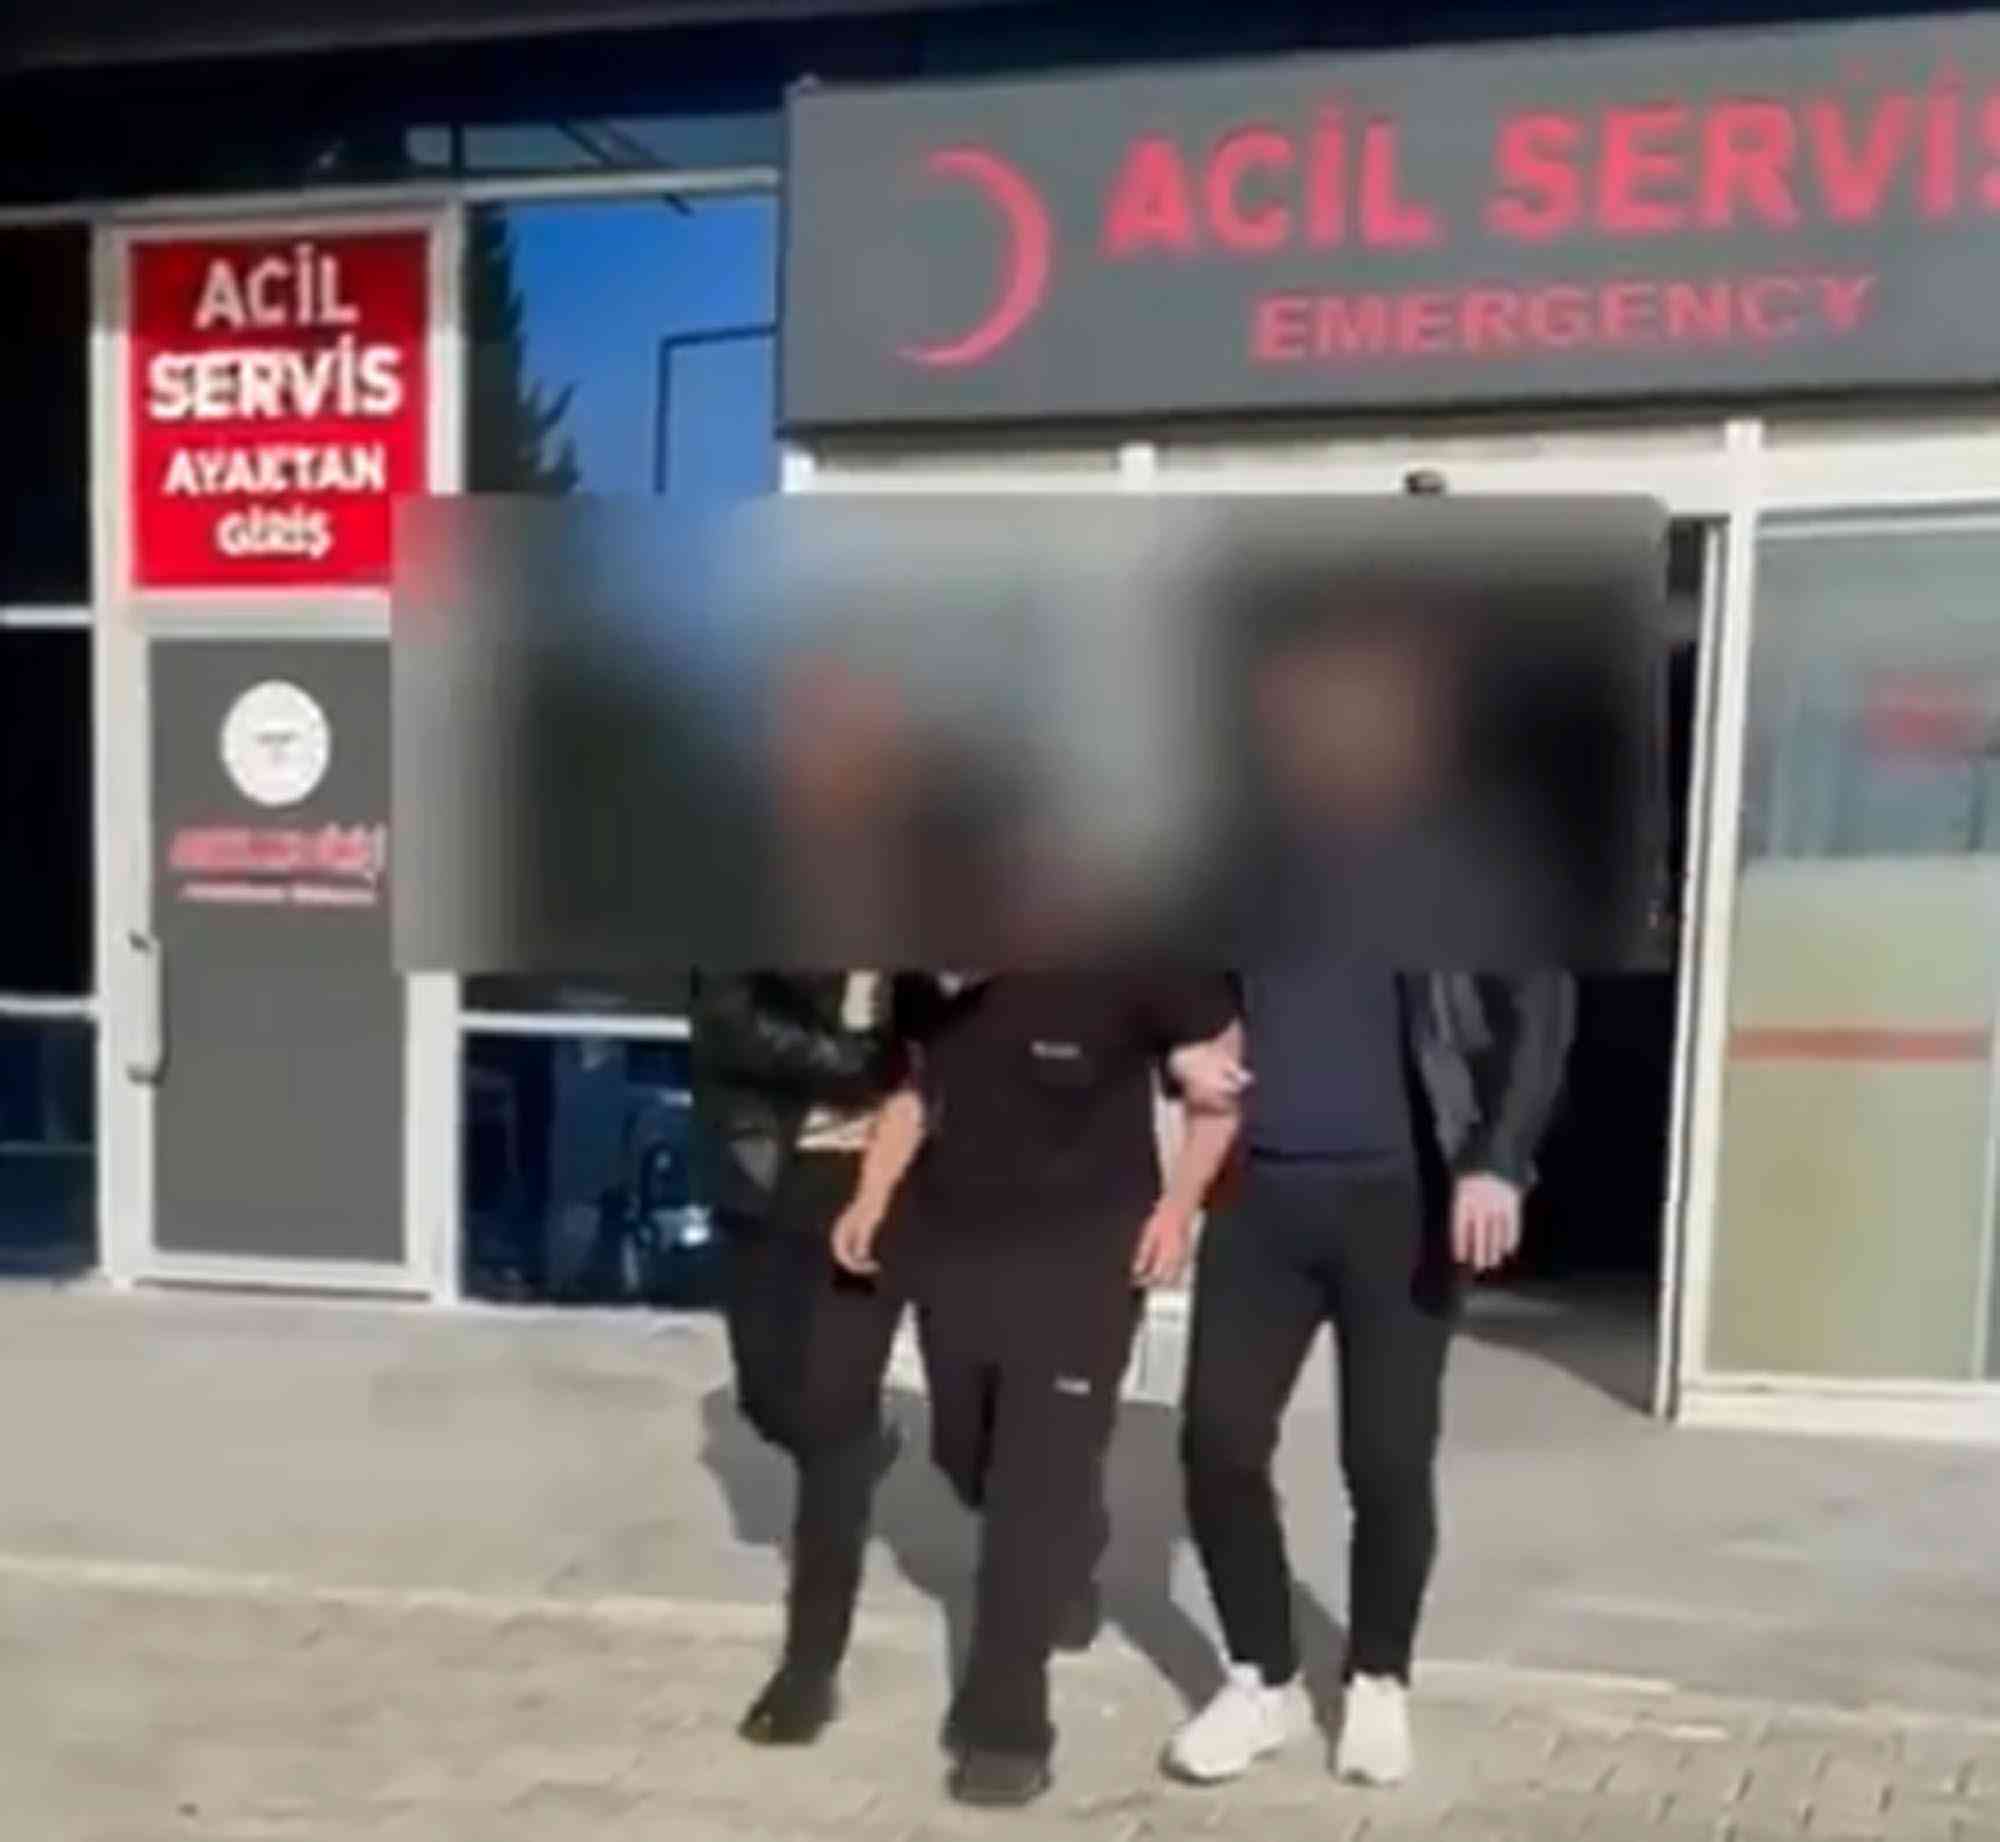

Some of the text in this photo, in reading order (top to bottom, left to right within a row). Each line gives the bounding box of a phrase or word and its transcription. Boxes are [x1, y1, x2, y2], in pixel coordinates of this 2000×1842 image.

[1102, 64, 2000, 258] ACİL SERVİ
[194, 245, 359, 328] ACİL
[1250, 274, 1876, 364] EMERGENCY
[149, 334, 401, 420] SERVİS
[163, 444, 386, 496] AYAKTAN
